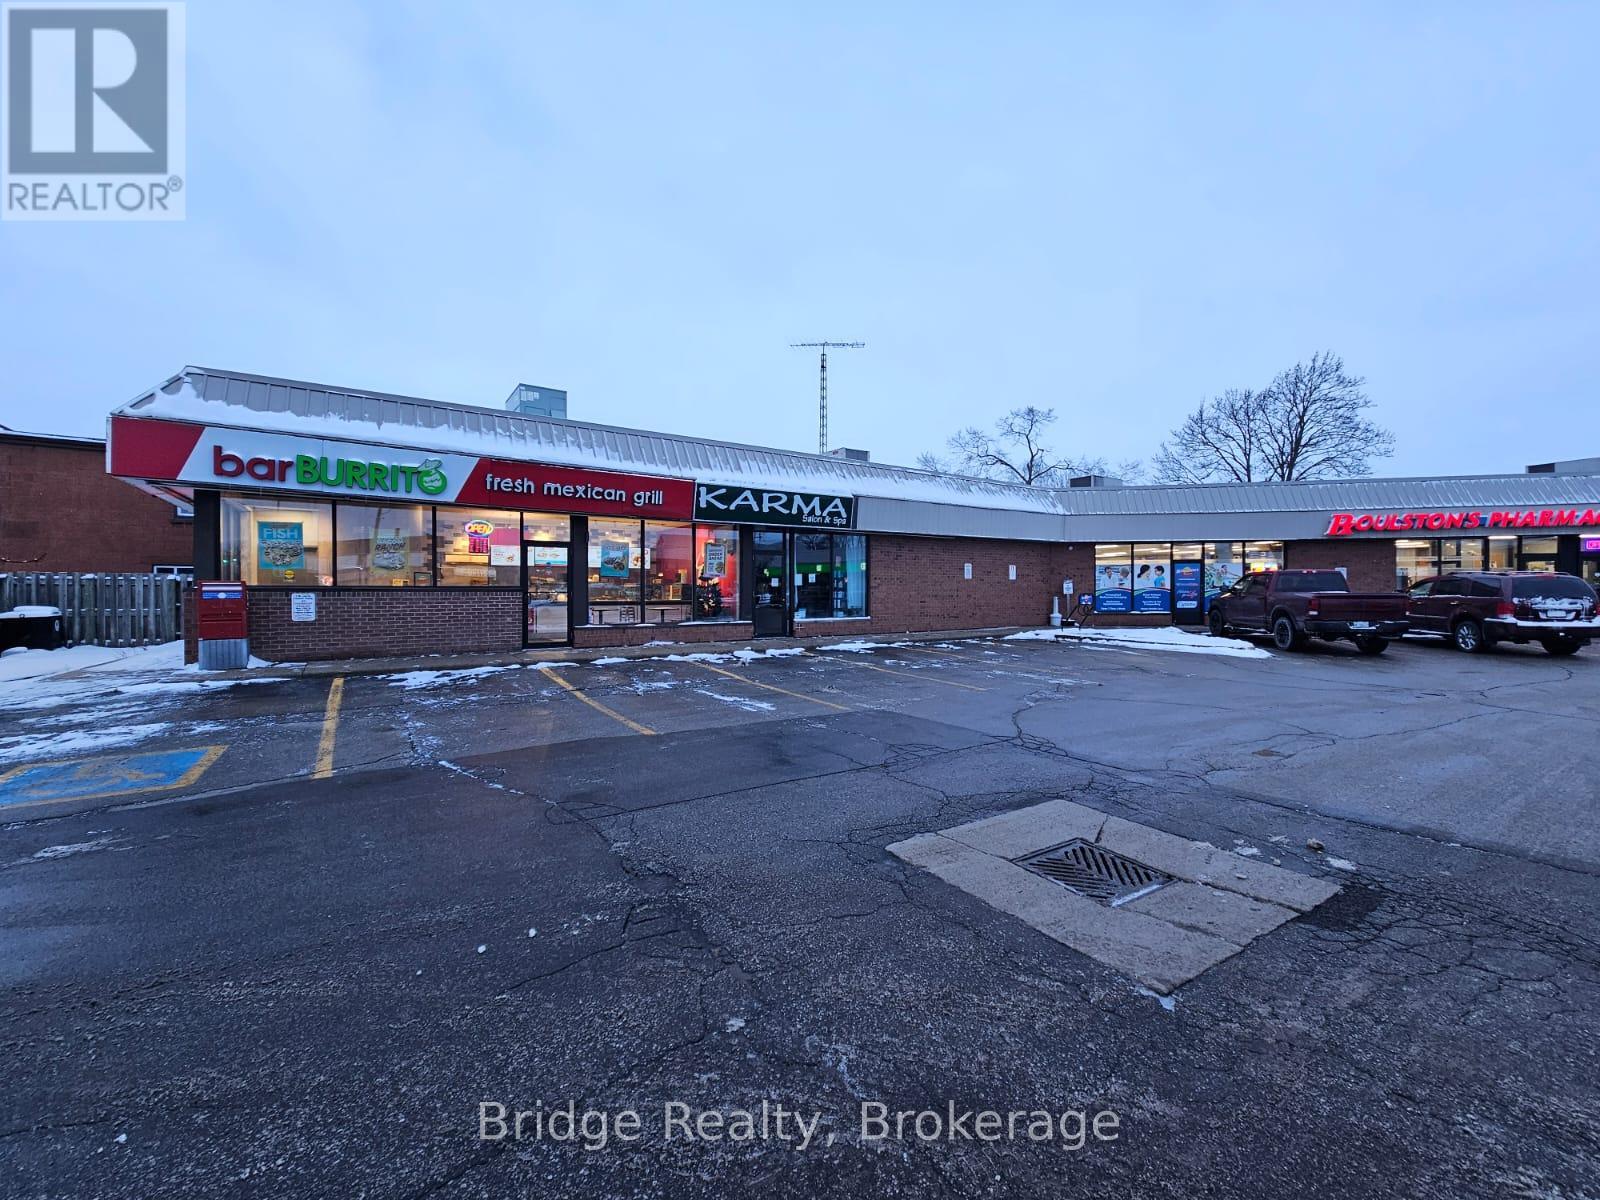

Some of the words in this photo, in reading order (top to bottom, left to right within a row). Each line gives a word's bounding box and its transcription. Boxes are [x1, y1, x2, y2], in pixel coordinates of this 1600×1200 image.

[486, 473, 535, 494] fresh
[543, 482, 626, 502] mexican
[633, 490, 663, 507] grill
[699, 486, 848, 518] KARMA
[802, 514, 823, 523] Salon
[833, 516, 847, 527] Spa
[1487, 508, 1600, 529] PHARMA
[263, 528, 298, 539] FISH
[466, 523, 490, 534] OPEN
